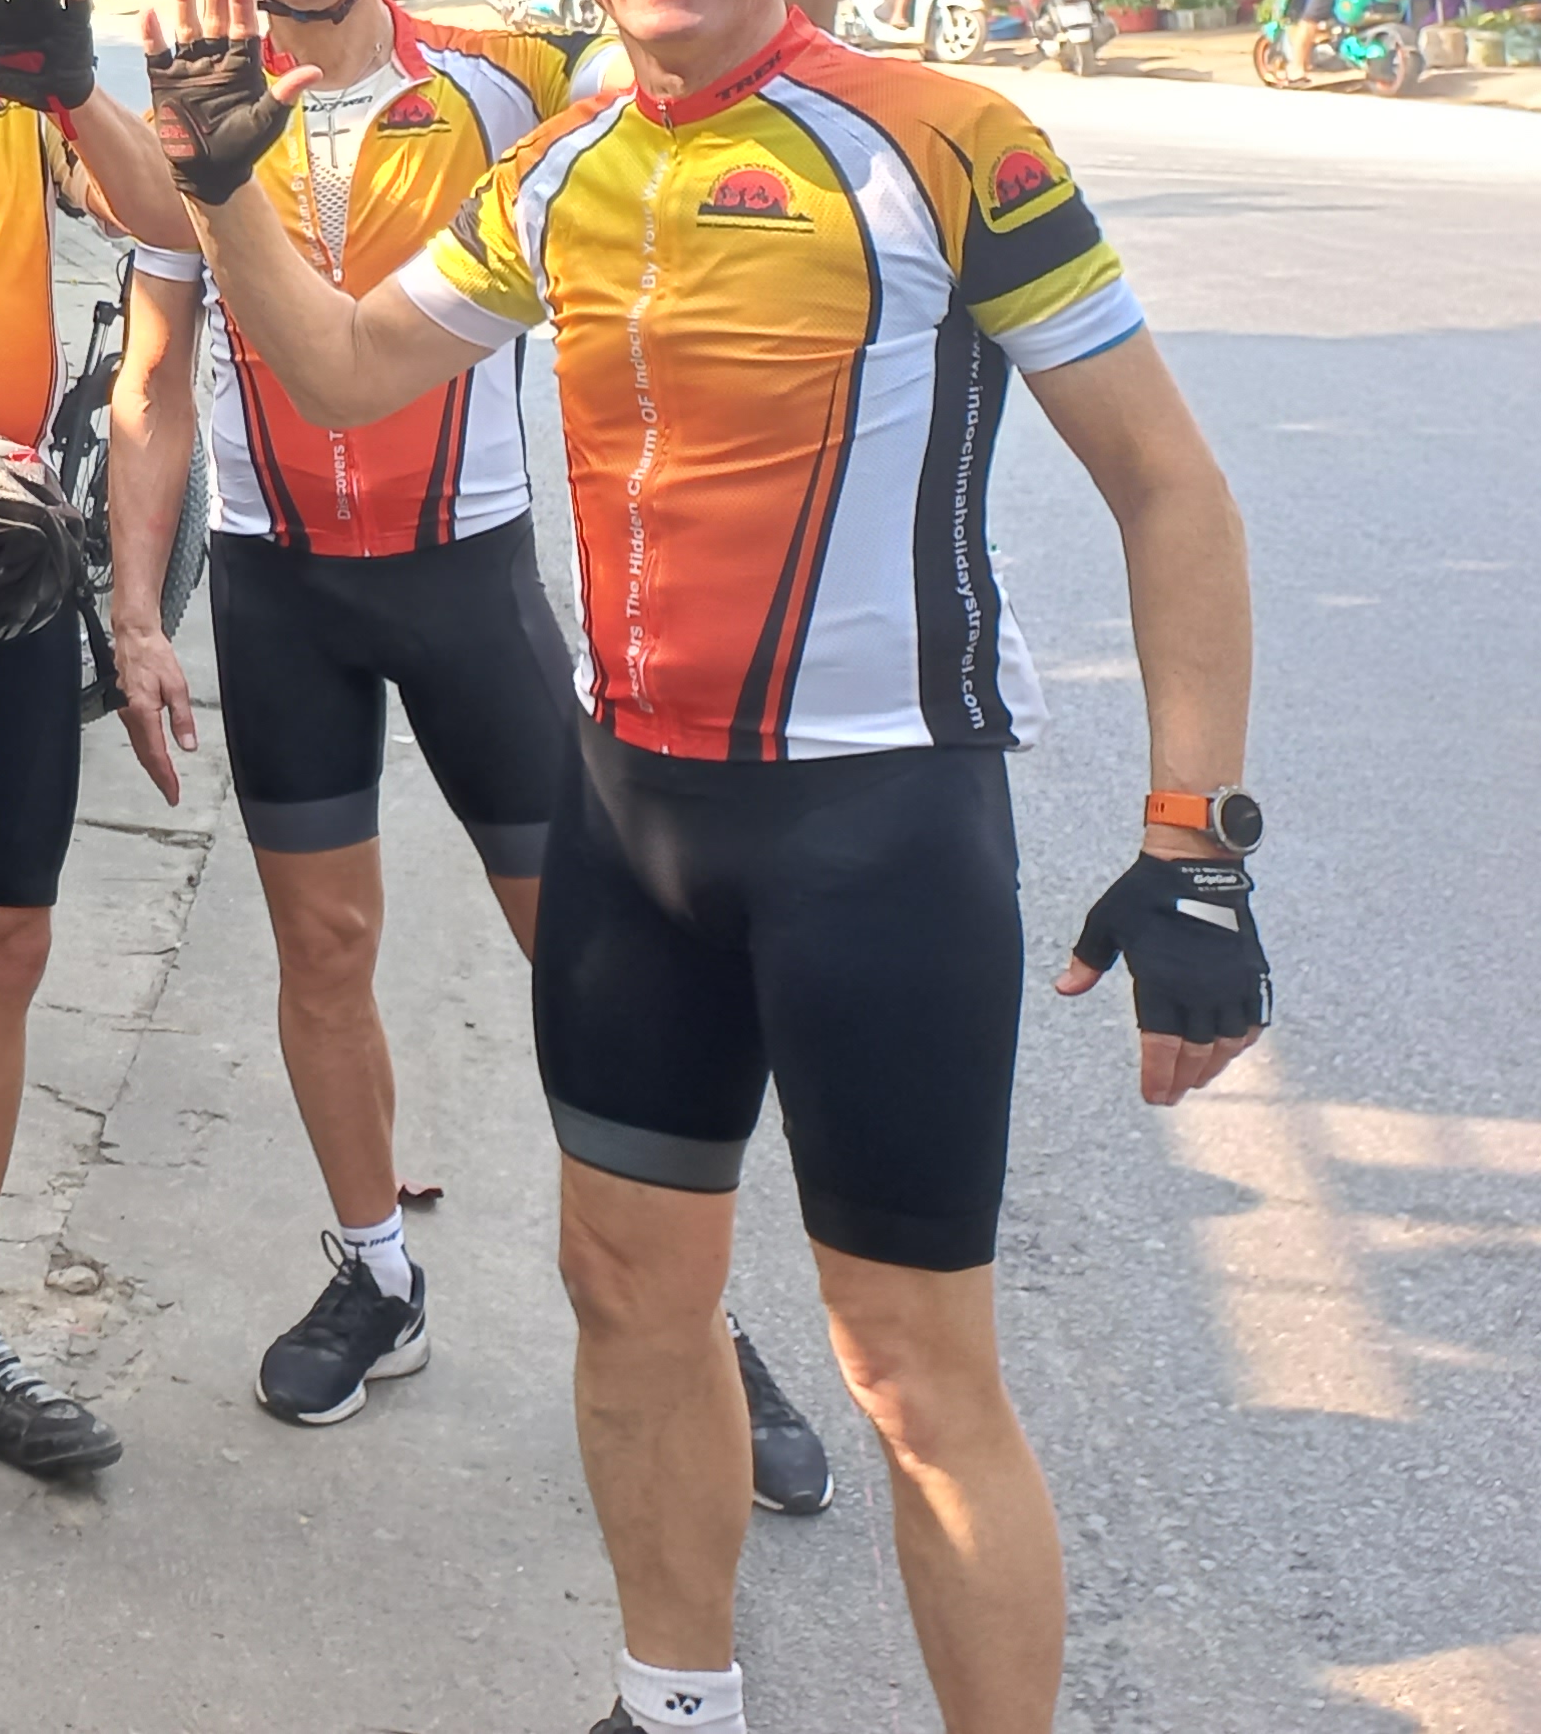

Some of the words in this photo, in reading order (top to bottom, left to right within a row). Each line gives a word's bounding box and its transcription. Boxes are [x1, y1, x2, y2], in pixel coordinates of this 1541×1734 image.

[640, 262, 661, 289] By
[639, 394, 658, 424] OF
[627, 428, 658, 496] Charm
[627, 501, 645, 576] Hidden
[626, 580, 641, 619] The
